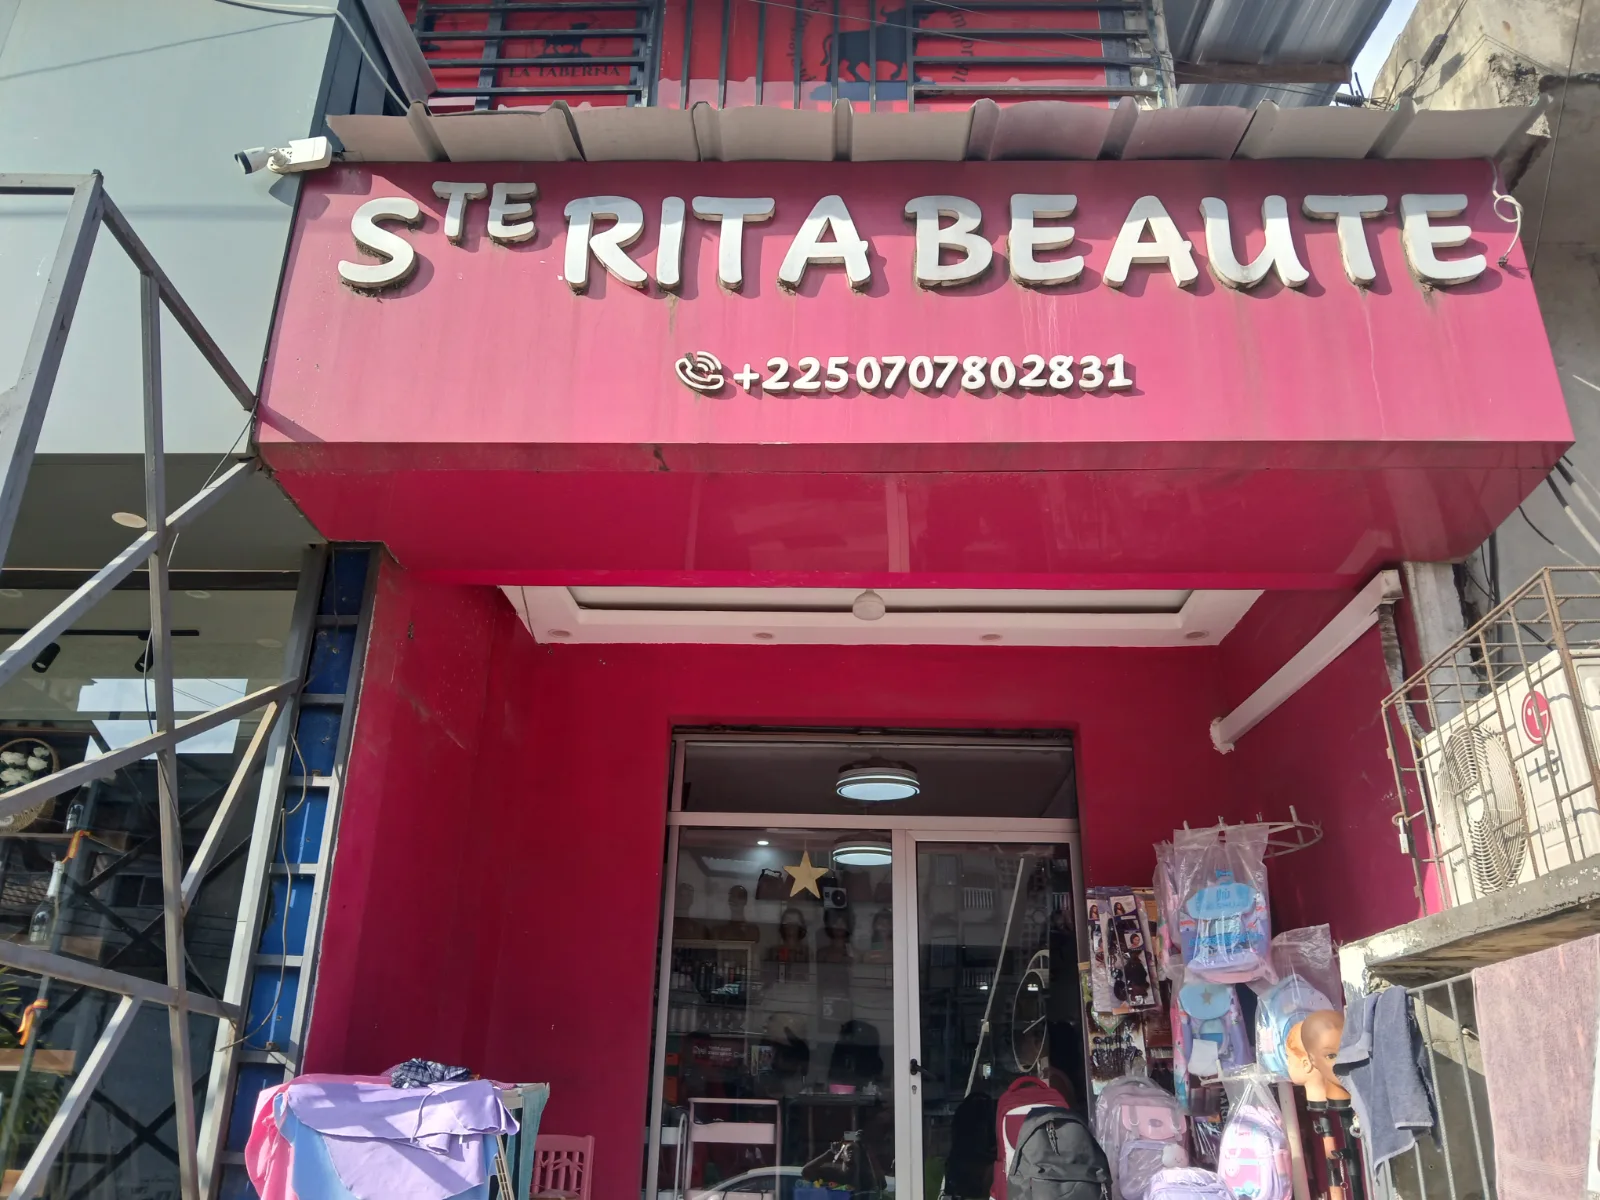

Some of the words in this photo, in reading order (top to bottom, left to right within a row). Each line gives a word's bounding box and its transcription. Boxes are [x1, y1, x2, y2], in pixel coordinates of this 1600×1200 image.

[563, 195, 873, 293] RITA
[904, 194, 1488, 289] BEAUTE
[733, 354, 1134, 395] +2250707802831
